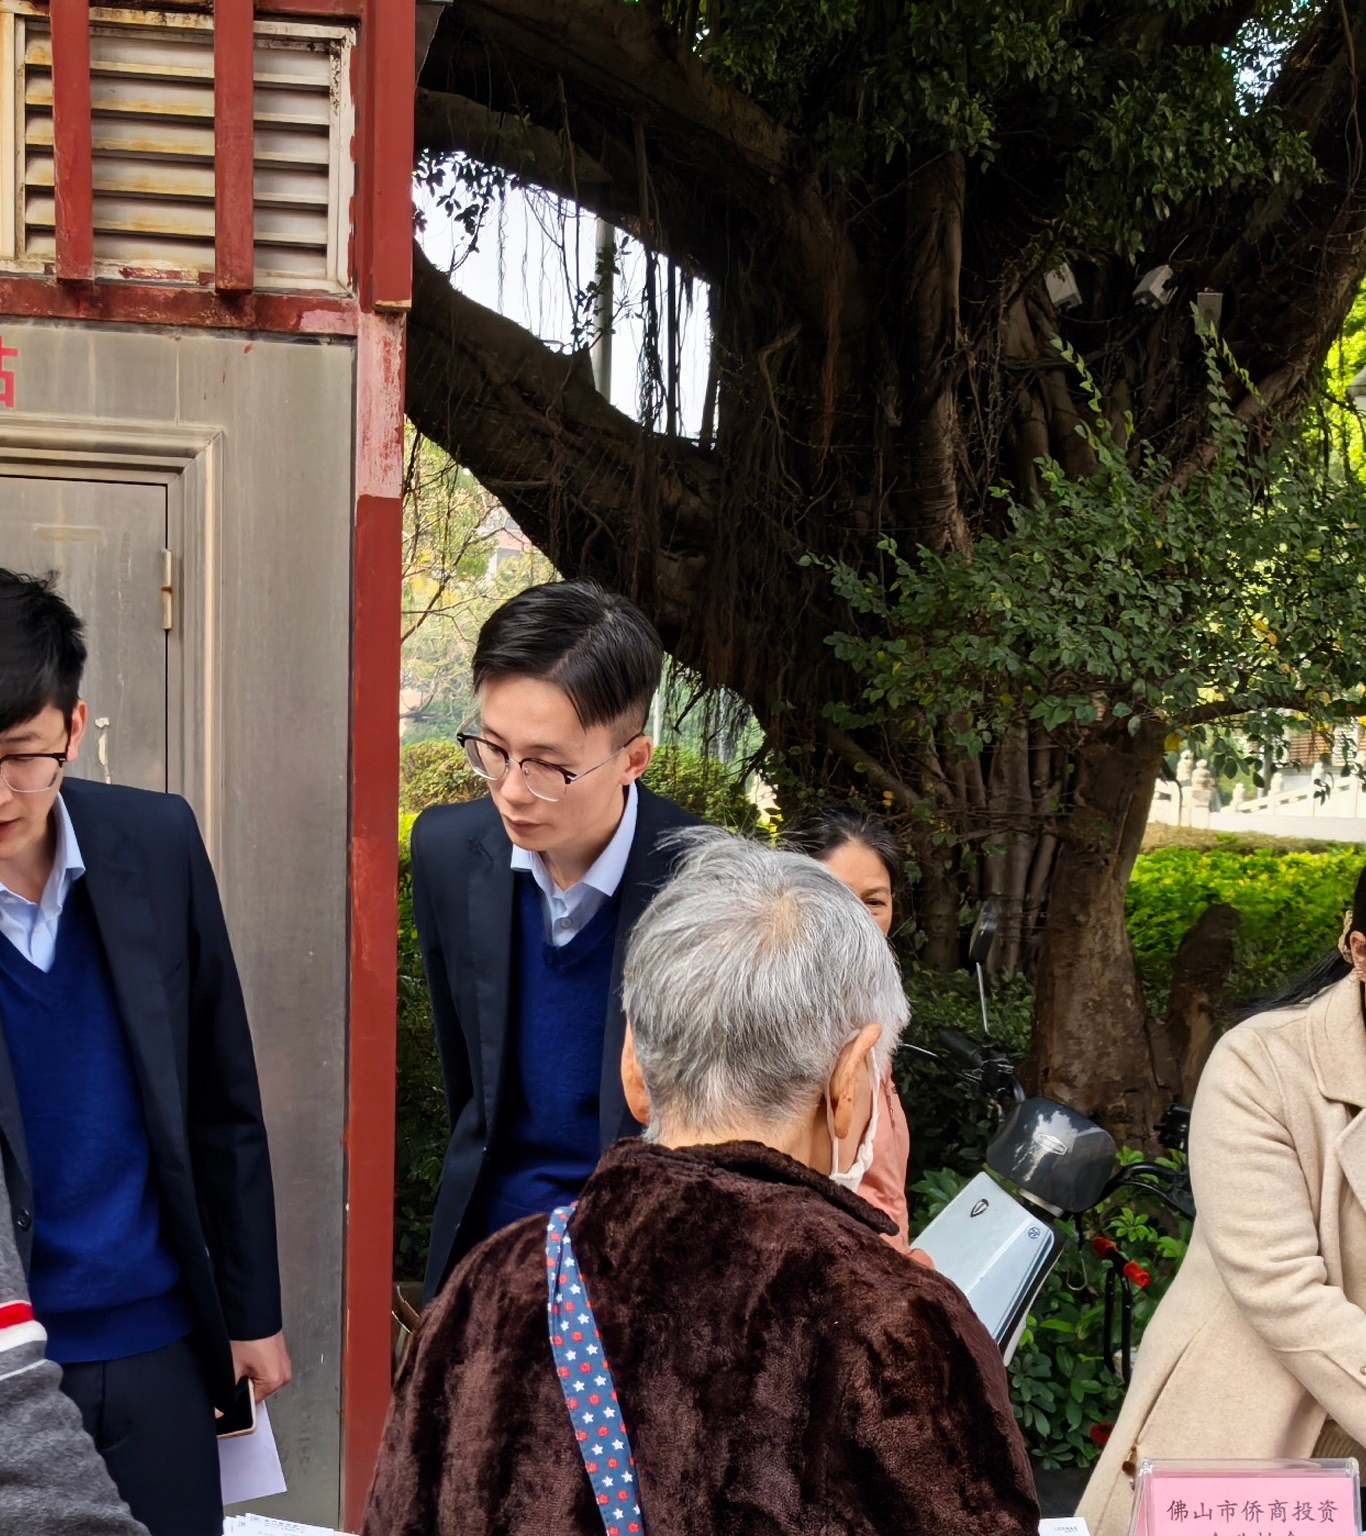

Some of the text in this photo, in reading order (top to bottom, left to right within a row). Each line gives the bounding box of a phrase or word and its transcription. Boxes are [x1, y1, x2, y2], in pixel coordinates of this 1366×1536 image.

[1166, 1499, 1339, 1524] 佛山市侨商投资
